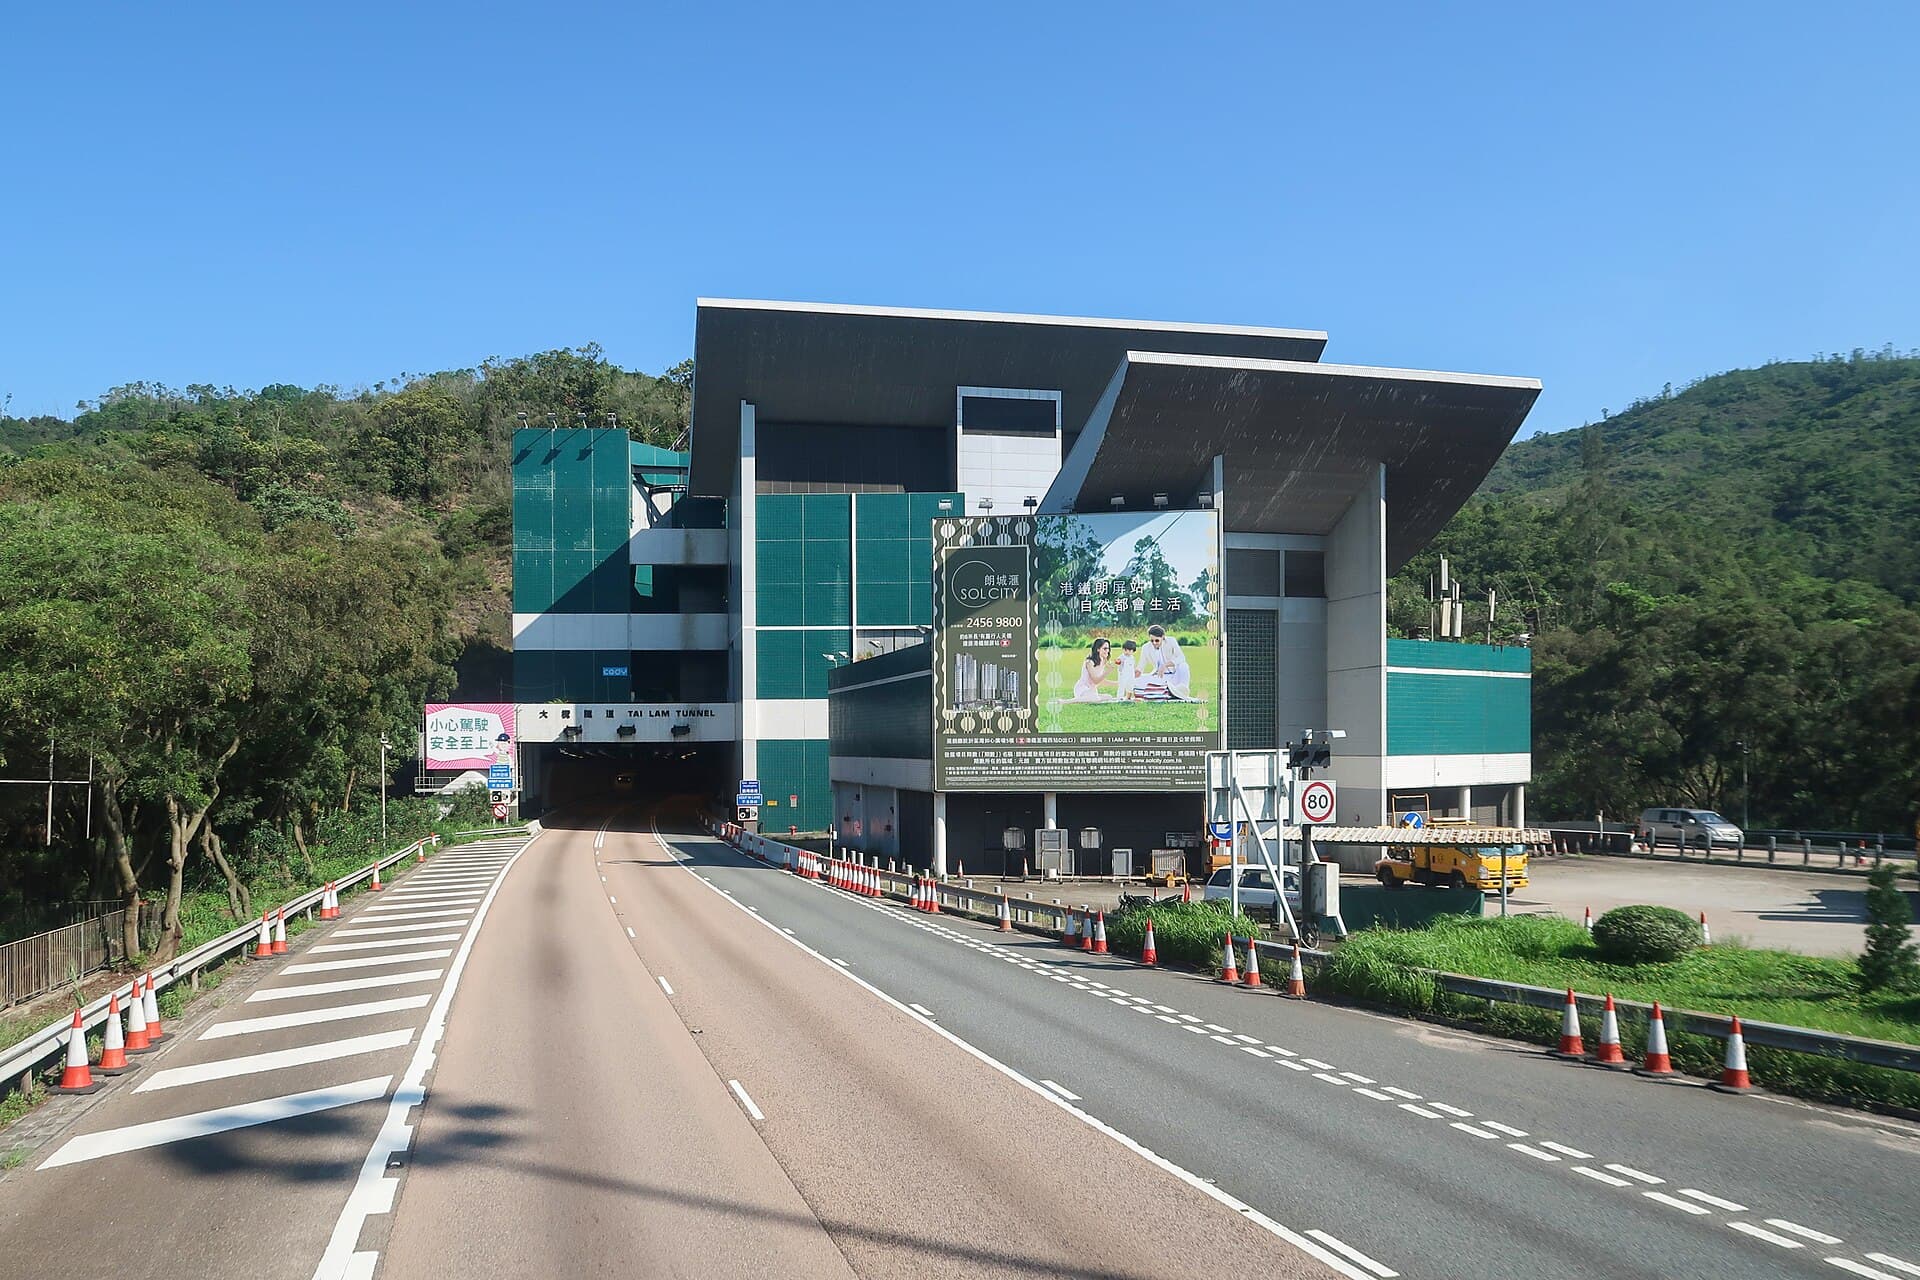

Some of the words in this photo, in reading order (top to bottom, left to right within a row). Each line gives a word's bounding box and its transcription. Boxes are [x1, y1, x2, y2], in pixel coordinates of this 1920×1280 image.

[1060, 580, 1144, 595] 港鐵朗屏站
[1080, 597, 1181, 612] 自然都會生活
[966, 617, 993, 628] 2456
[995, 616, 1023, 628] 9800
[628, 710, 643, 718] TAI
[648, 709, 670, 718] LAM
[675, 709, 715, 718] TUNNEL
[430, 717, 488, 732] 小心駕駛
[430, 735, 488, 750] 安全至上
[1308, 794, 1328, 809] 80
